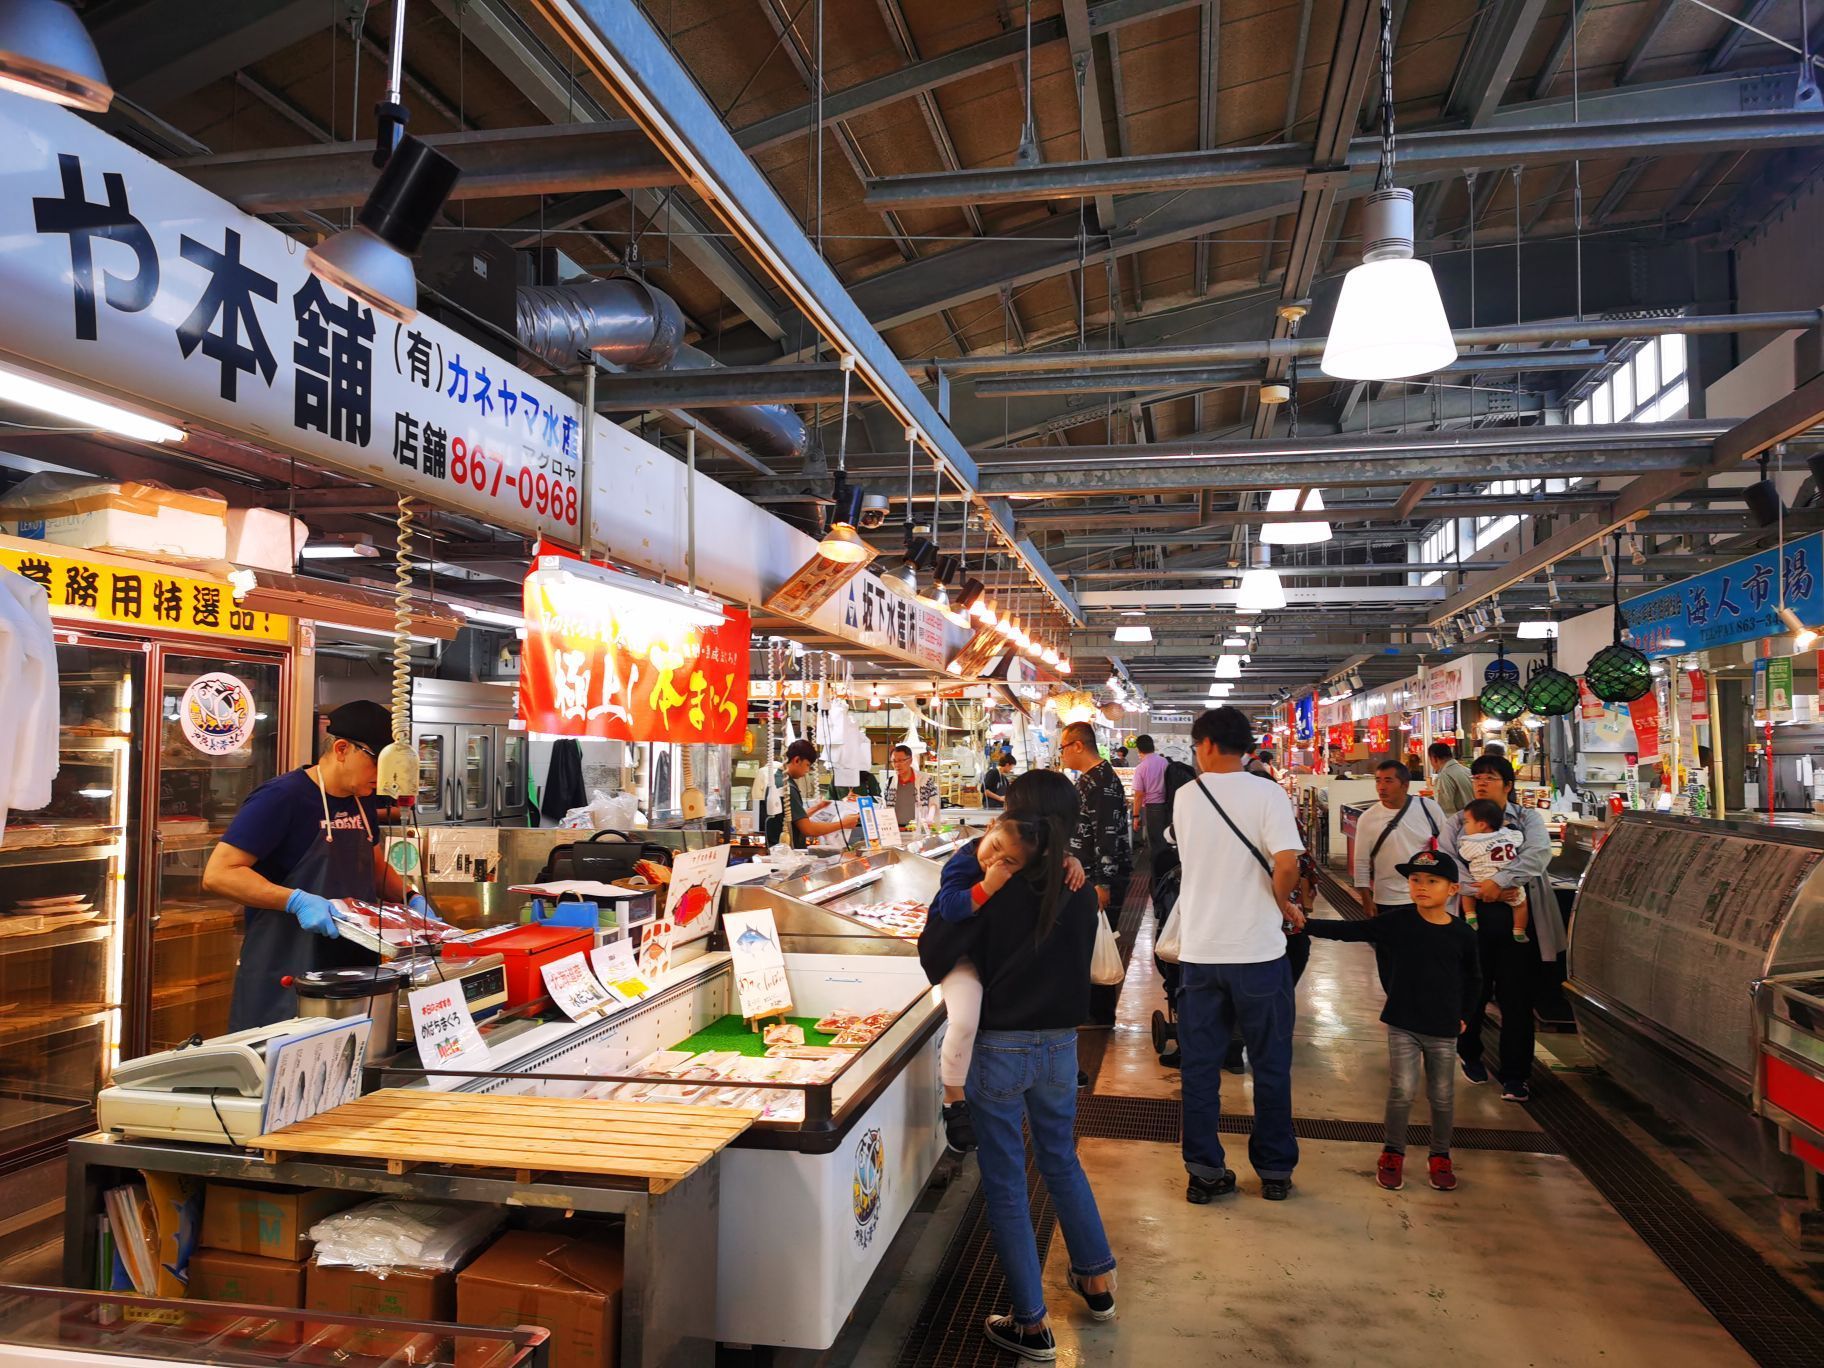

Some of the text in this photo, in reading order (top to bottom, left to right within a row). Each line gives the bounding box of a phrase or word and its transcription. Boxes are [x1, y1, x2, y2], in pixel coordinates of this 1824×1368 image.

[32, 153, 376, 447] や本舗
[393, 411, 578, 526] 店舗 867-0968
[522, 444, 577, 482] マグロヤ
[1686, 548, 1814, 627] 海人市場
[1490, 843, 1517, 862] 28
